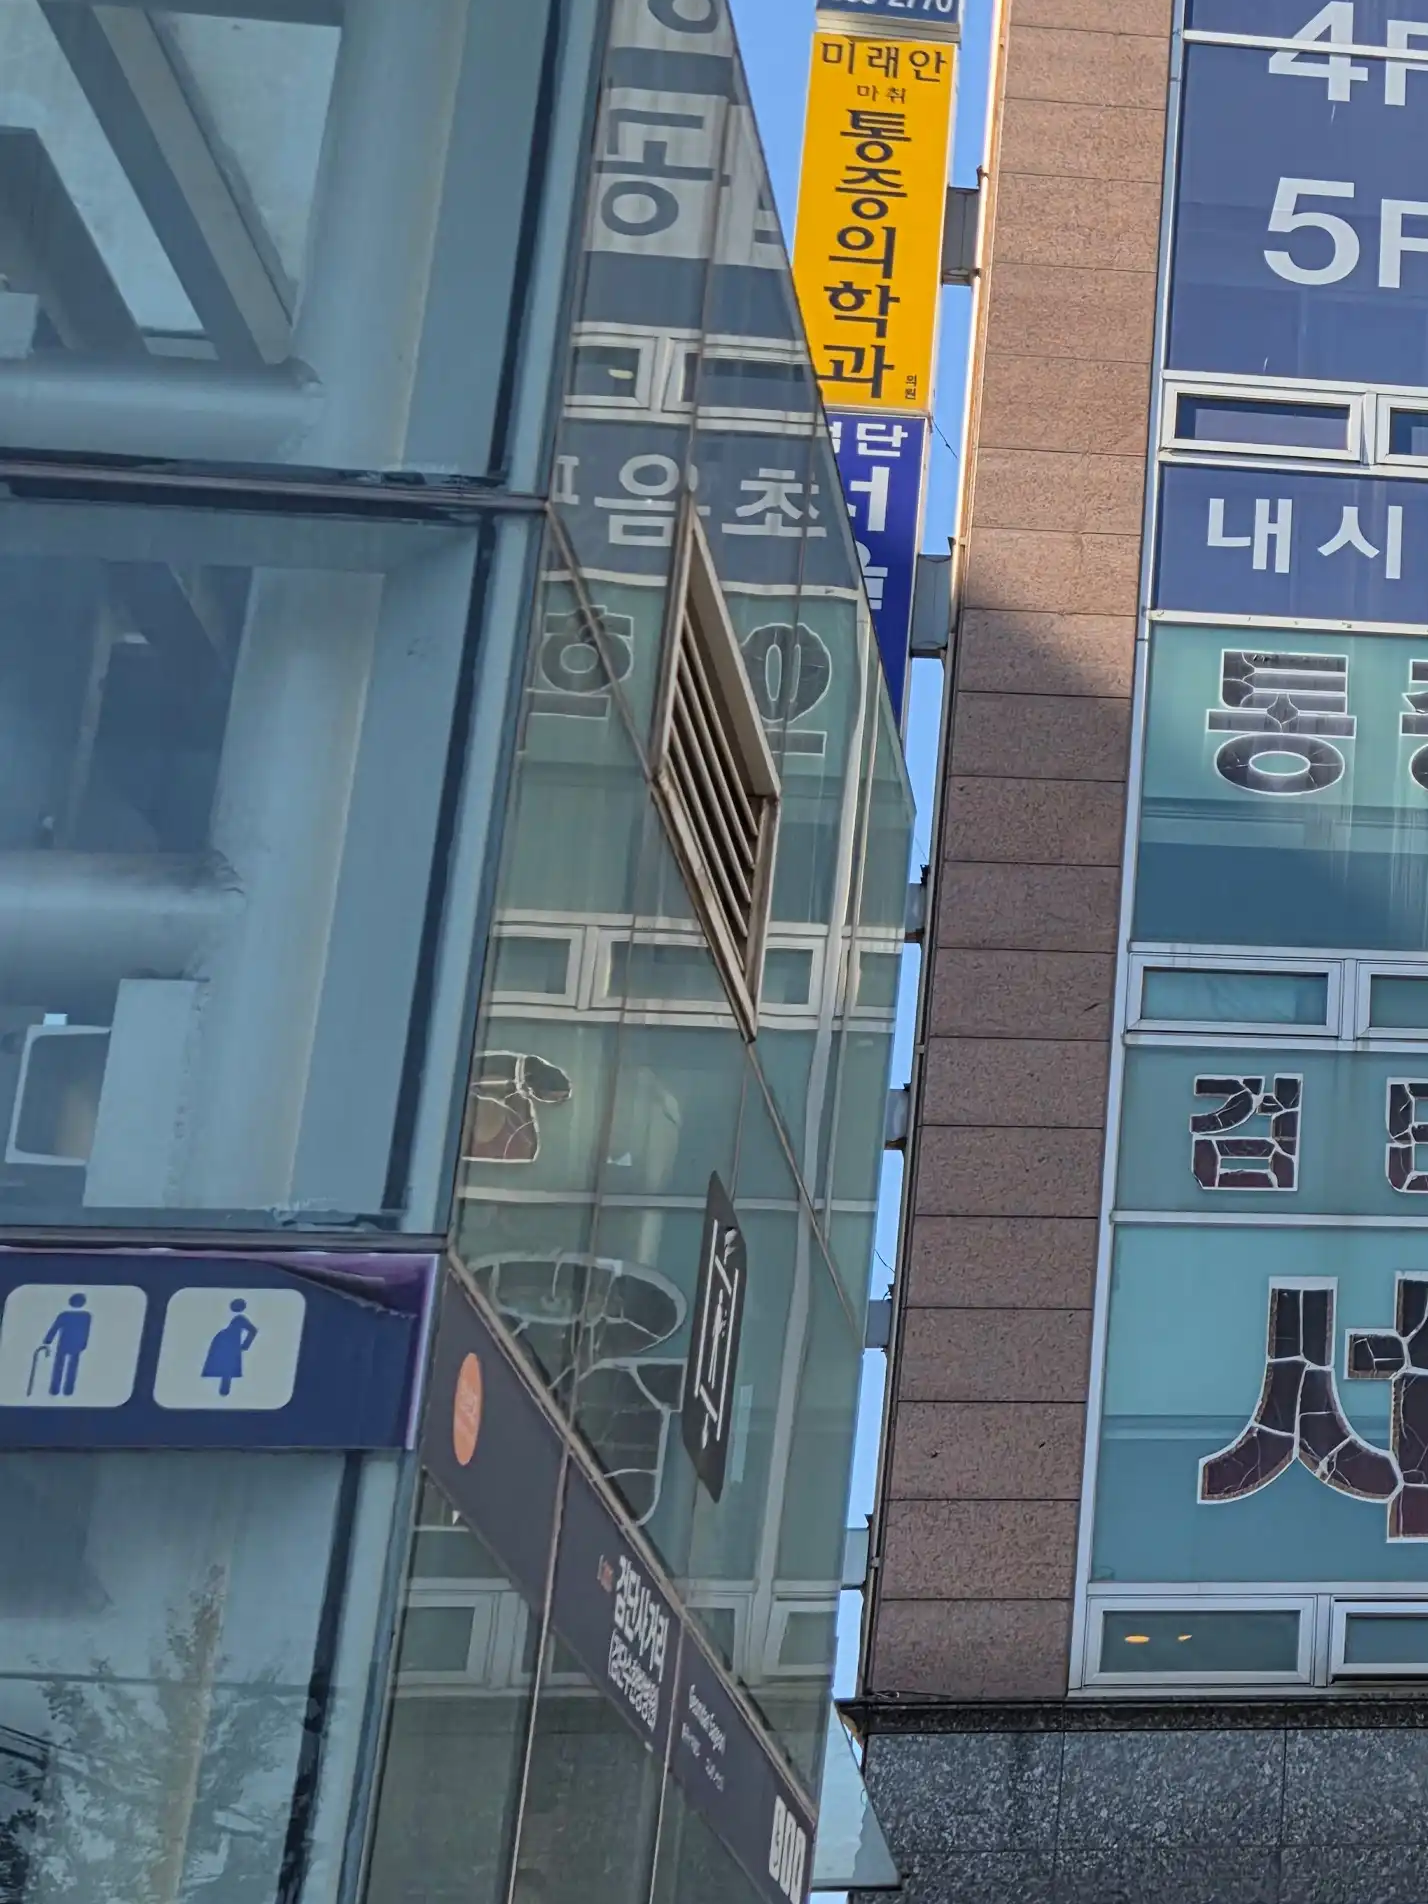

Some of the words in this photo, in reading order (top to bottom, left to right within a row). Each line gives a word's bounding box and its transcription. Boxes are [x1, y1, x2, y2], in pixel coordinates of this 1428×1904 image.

[821, 40, 949, 84] 미래안
[856, 84, 907, 104] 마취
[816, 108, 912, 400] 통증의학과
[828, 421, 909, 458] 단
